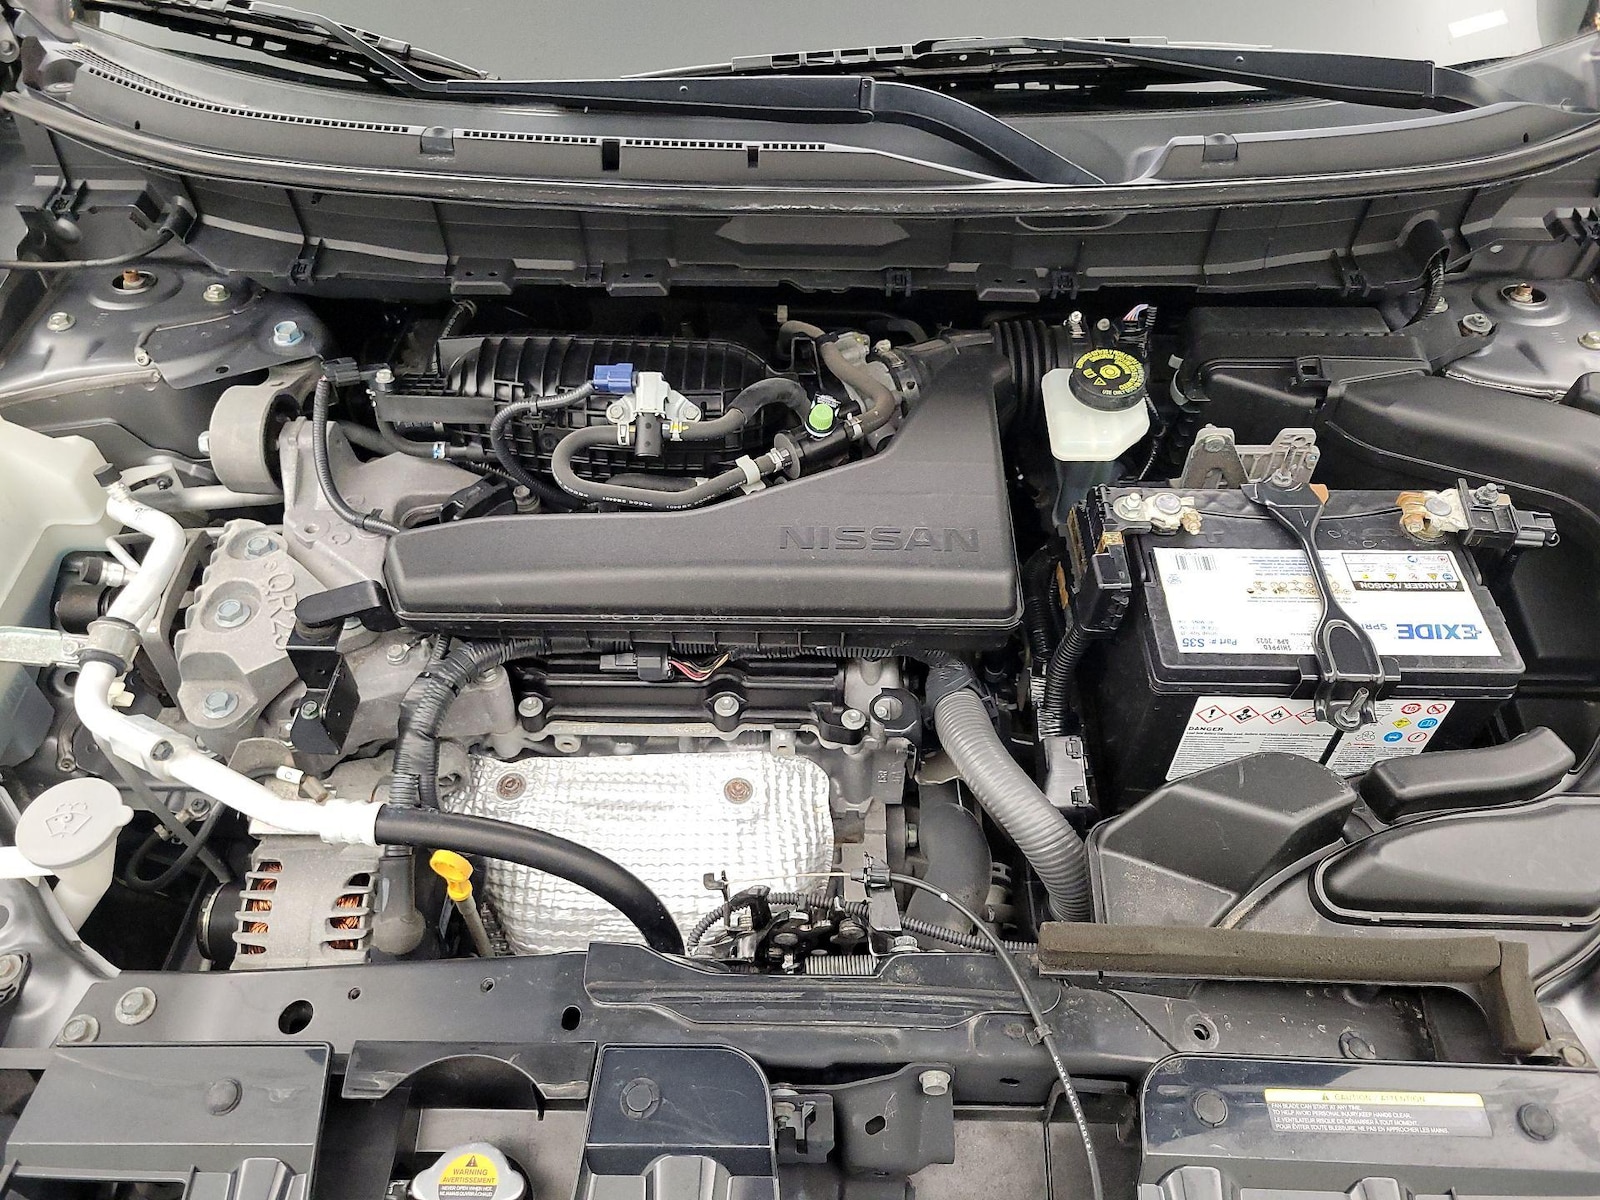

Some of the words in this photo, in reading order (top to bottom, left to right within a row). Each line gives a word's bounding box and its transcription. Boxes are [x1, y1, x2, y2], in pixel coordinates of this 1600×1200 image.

[779, 525, 980, 552] NISSAN
[1396, 623, 1482, 640] EXIDE
[1182, 638, 1205, 648] S35
[1219, 638, 1237, 646] Part
[1256, 637, 1273, 645] 2025
[285, 771, 293, 779] C
[453, 1168, 488, 1176] WARNING
